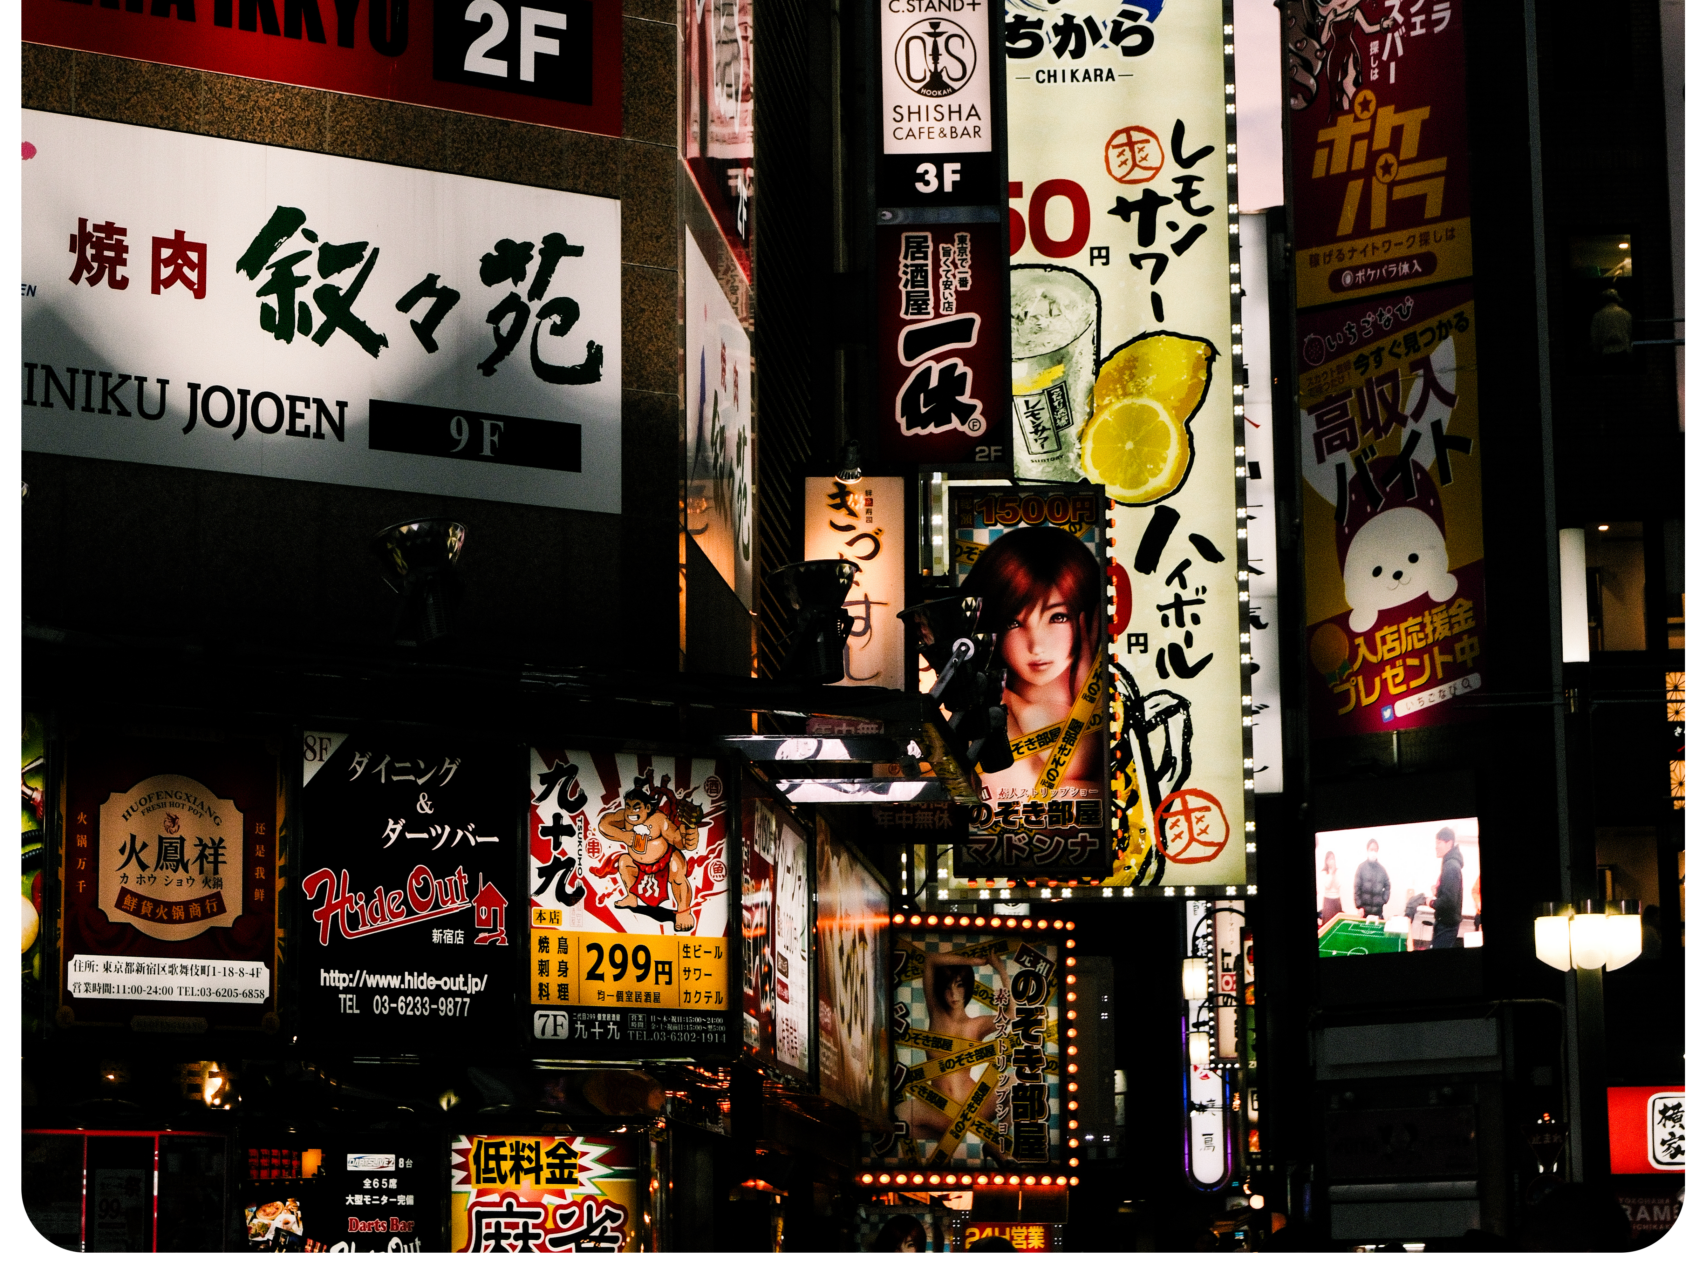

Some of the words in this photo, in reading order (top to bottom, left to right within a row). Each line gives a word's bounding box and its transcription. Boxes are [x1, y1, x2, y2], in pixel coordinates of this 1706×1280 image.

[1005, 8, 1155, 60] ちから
[1035, 68, 1116, 84] CHIKARA
[1369, 39, 1380, 81] 探しは
[920, 87, 953, 97] HOOKAH
[892, 103, 982, 123] SHISHA
[914, 161, 962, 194] 3F
[1165, 118, 1215, 257] レモン
[956, 233, 969, 289] 東京で一番
[1089, 246, 1110, 266] 円
[1107, 188, 1174, 323] サワー
[902, 234, 931, 316] 居酒屋
[941, 245, 953, 312] 旨くて安い店
[69, 216, 207, 300] 焼肉
[236, 205, 604, 385] 叙々苑
[1353, 310, 1470, 376] 今すぐ見つかる
[901, 317, 977, 432] 一休
[182, 381, 348, 442] JOJOEN
[1306, 353, 1459, 465] 高収入
[447, 414, 504, 458] 9F
[974, 445, 1003, 462] 2F
[1334, 418, 1474, 526] バイト
[975, 495, 1097, 525] 1500円
[1126, 632, 1149, 655] 円
[1350, 597, 1477, 673] 入店応援金
[1332, 634, 1481, 716] プレゼント中
[303, 735, 332, 762] 8F
[347, 750, 462, 788] ダイニング
[121, 789, 223, 827] HUOFENGXIANG
[141, 801, 167, 817] FRESH
[169, 800, 186, 811] HOT
[187, 805, 204, 819] POT
[416, 791, 435, 814] &
[968, 799, 1103, 829] のぞき部屋
[381, 817, 500, 851] ダーツバー
[533, 761, 589, 907] 九十九
[576, 816, 584, 878] TSUKUMO
[967, 832, 1101, 867] マドンナ
[117, 832, 228, 876] 火鳳祥
[302, 867, 407, 947] Hide
[407, 864, 469, 914] Out
[535, 910, 560, 925] 本店
[431, 927, 465, 945] 新宿店
[538, 935, 569, 955] 焼鳥
[682, 943, 723, 960] 生ビール
[537, 958, 569, 978] 刺身
[585, 941, 673, 986] 299円
[683, 966, 712, 981] サワー
[319, 967, 488, 995] http://www.hide-out.jp/
[538, 982, 570, 1001] 料理
[683, 989, 724, 1005] カクテル
[338, 993, 361, 1014] TEL
[372, 994, 471, 1017] 03-6233-9877
[537, 1013, 568, 1037] 7F
[574, 1020, 621, 1041] 九十九
[1010, 968, 1050, 1163] のぞき部屋
[473, 1140, 580, 1186] 低料金
[347, 1216, 387, 1233] Darts
[389, 1216, 415, 1233] Bar
